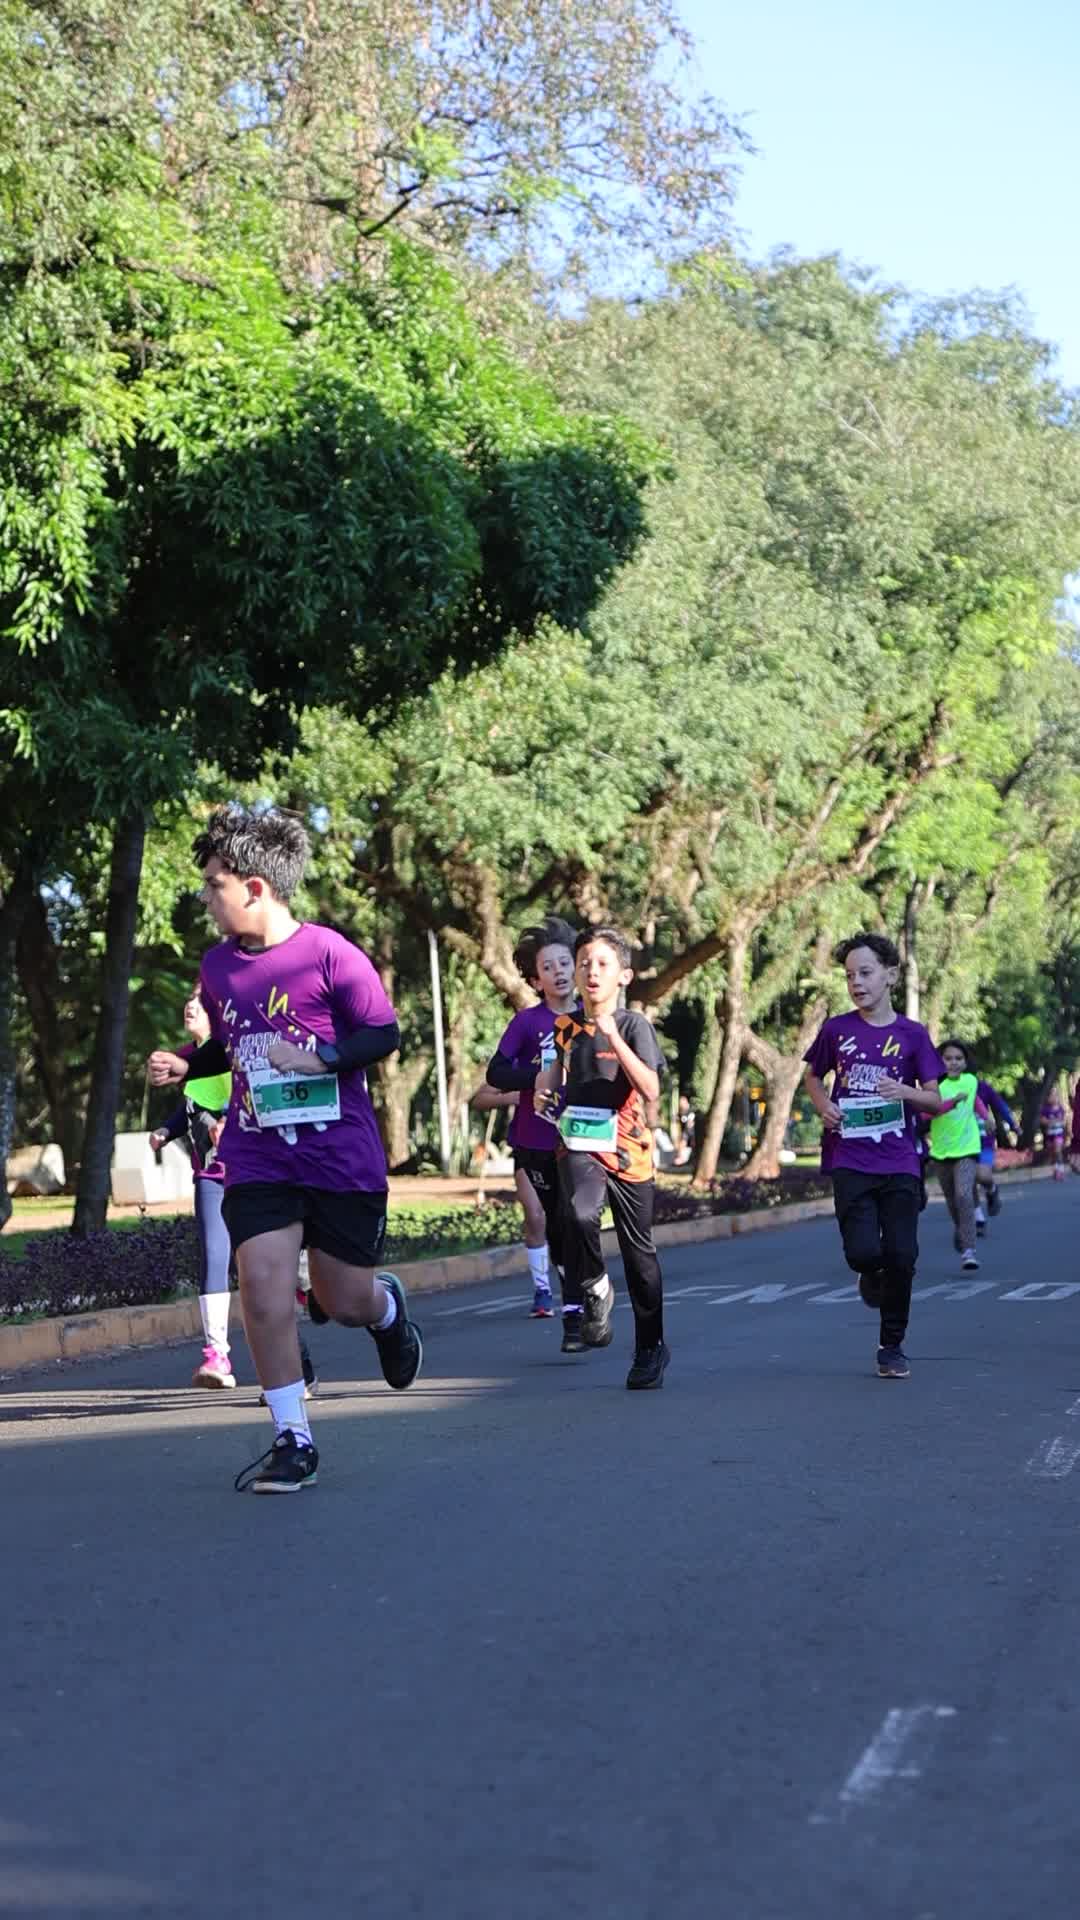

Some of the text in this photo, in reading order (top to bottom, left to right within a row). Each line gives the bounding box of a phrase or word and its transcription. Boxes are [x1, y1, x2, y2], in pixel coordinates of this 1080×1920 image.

[238, 1054, 271, 1072] Cria
[281, 1082, 309, 1102] 56
[847, 1078, 880, 1092] Crian
[864, 1107, 883, 1122] 55
